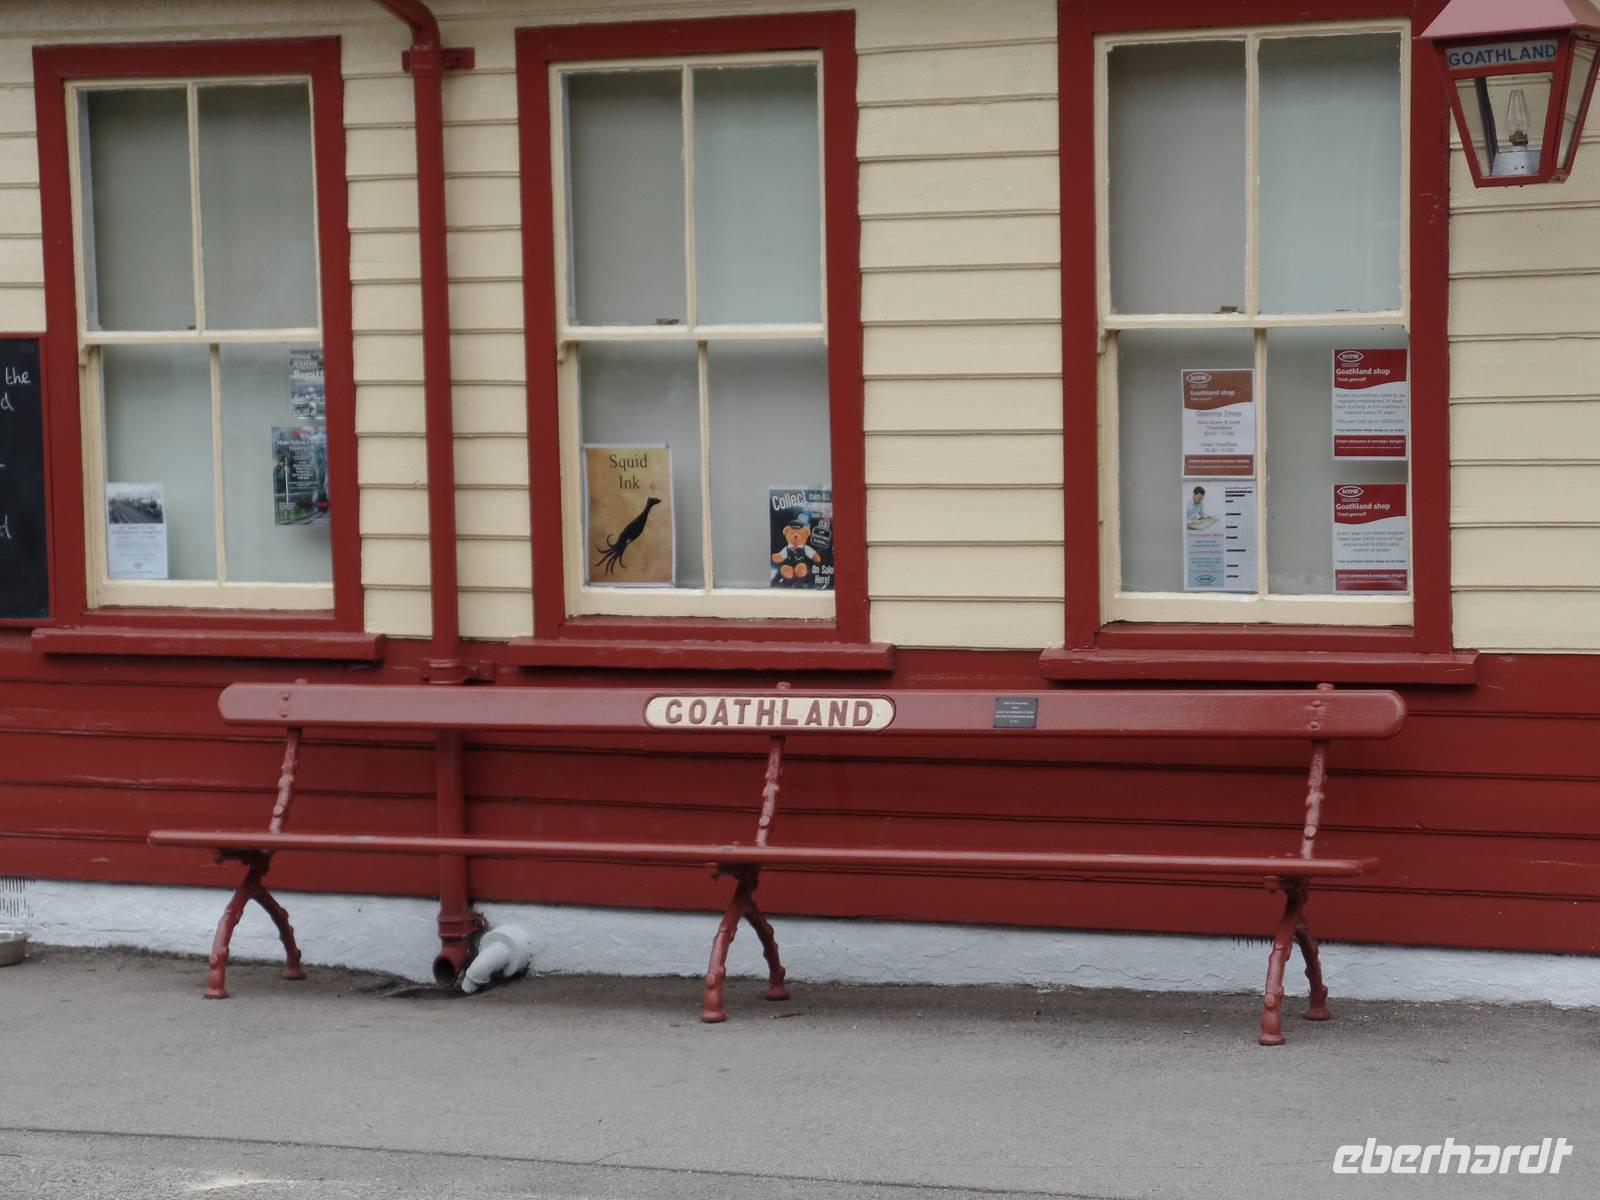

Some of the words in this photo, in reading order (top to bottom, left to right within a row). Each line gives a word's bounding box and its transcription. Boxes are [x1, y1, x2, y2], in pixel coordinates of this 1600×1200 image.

[1448, 45, 1556, 66] GOATHLAND
[5, 366, 32, 386] the
[1373, 368, 1391, 376] shop
[1220, 389, 1235, 397] shop
[609, 454, 648, 471] Squid
[619, 475, 640, 490] Ink
[772, 490, 808, 511] Collect
[1373, 503, 1391, 511] shop
[812, 564, 820, 574] On
[815, 575, 831, 585] Here!
[665, 699, 874, 727] GOATHLAND
